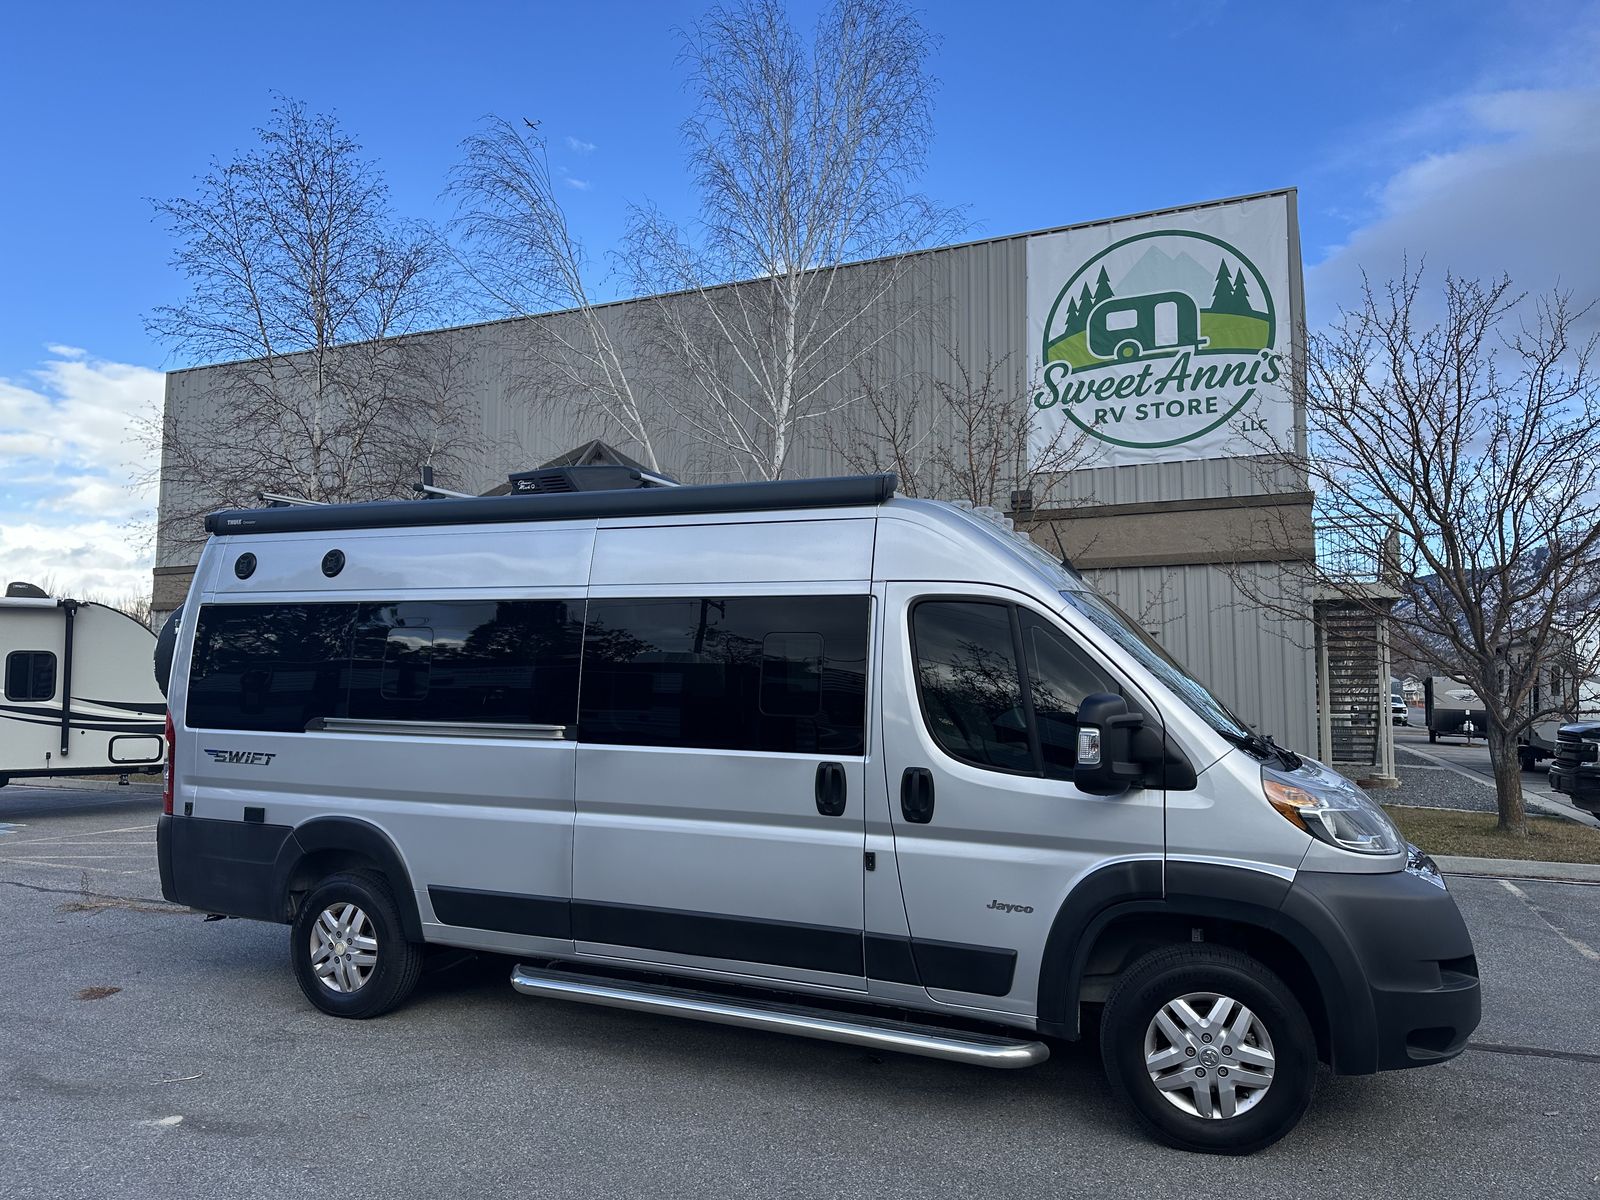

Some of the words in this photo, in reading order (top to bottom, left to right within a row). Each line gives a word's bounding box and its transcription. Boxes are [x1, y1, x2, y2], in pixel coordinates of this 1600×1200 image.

[1034, 362, 1154, 409] Sweet
[1154, 352, 1282, 395] Anni's
[1095, 406, 1126, 424] RV
[1136, 397, 1218, 421] STORE
[1243, 419, 1268, 432] LLC
[986, 899, 1034, 914] Jayco
